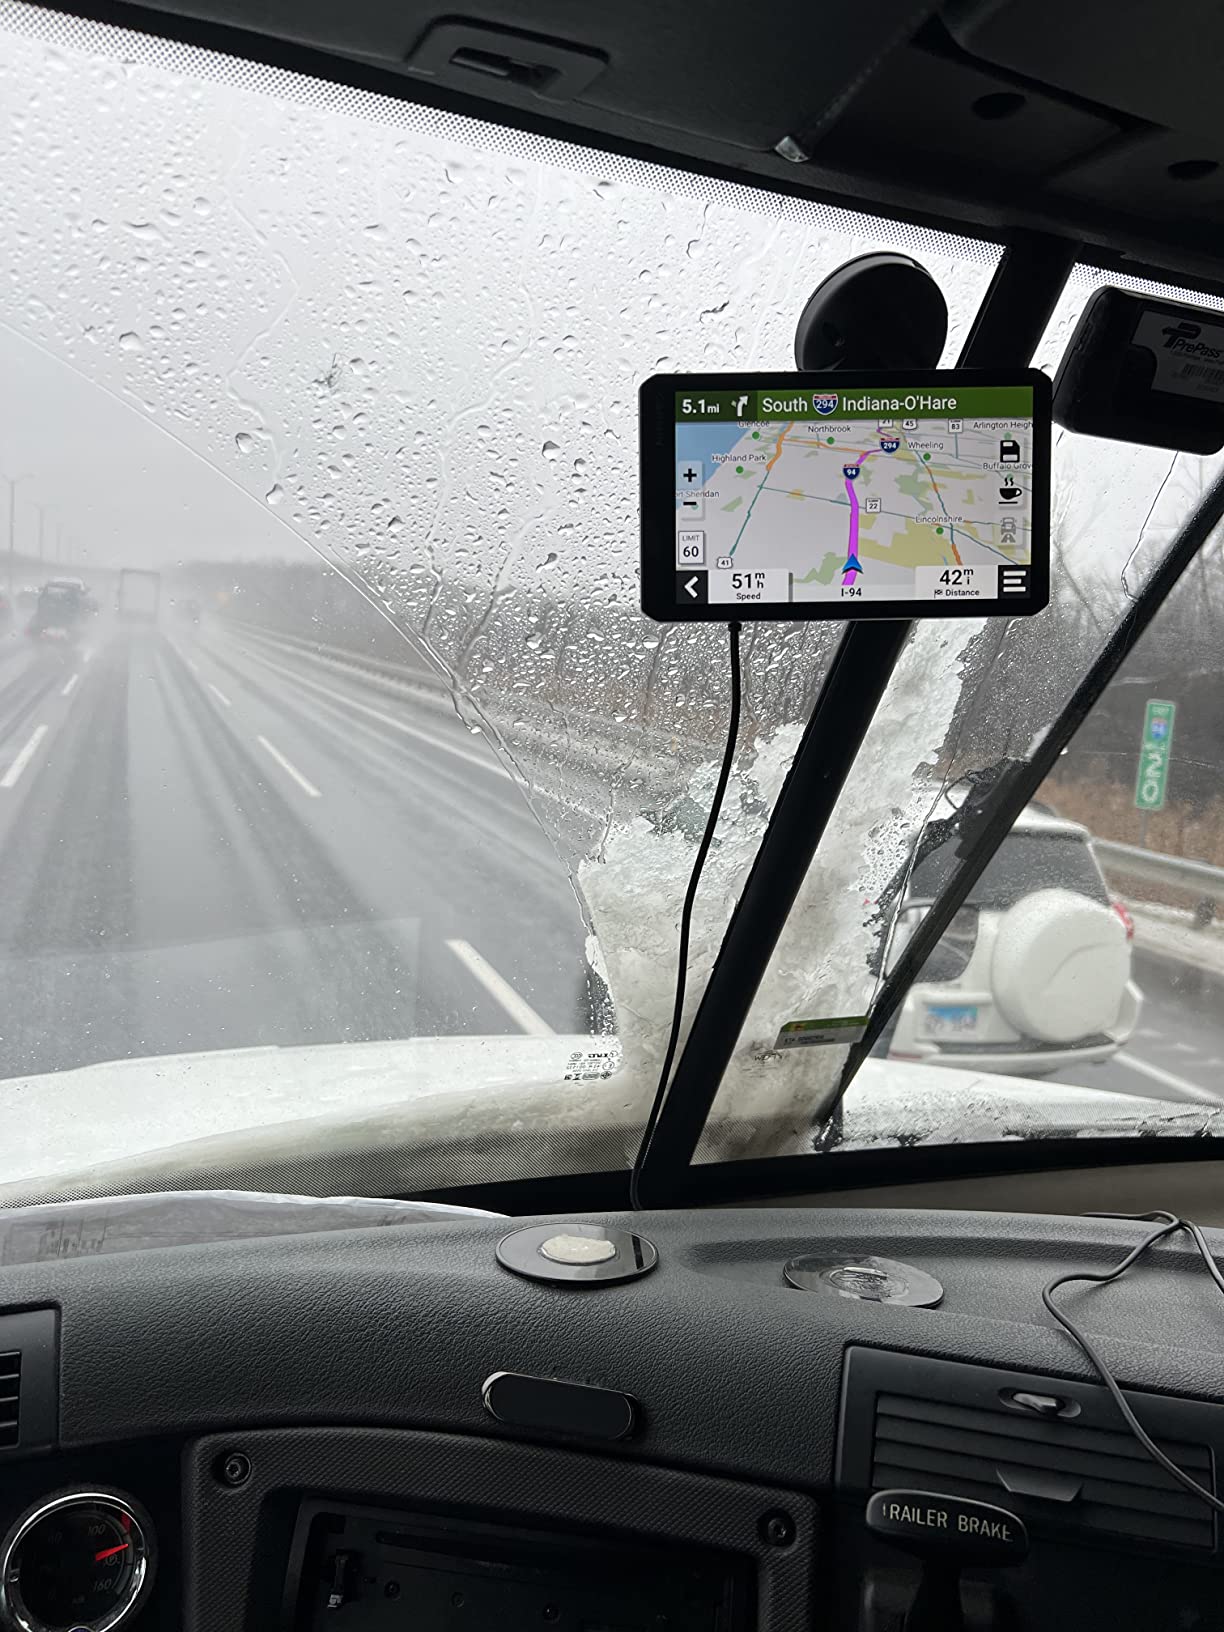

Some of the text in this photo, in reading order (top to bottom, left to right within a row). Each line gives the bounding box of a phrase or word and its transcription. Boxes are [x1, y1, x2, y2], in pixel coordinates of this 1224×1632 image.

[1174, 336, 1222, 359] PrePass
[762, 395, 957, 413] South 294 Indiana-O'Hare
[808, 425, 851, 433] Northbrook
[973, 421, 1008, 430] Arlington
[883, 441, 897, 450] 294
[908, 441, 944, 450] Wheeling
[712, 454, 767, 462] Highland Park
[983, 462, 1013, 470] Buffalo
[847, 468, 856, 476] 94
[685, 490, 720, 498] Sheridan
[869, 502, 878, 510] 22
[915, 515, 963, 523] Lincolnshire
[683, 546, 699, 558] 60
[732, 574, 752, 589] 51
[939, 570, 963, 585] 42
[841, 587, 862, 597] I-94
[945, 588, 980, 597] Distance
[736, 592, 761, 602] Speed
[958, 1515, 1014, 1542] BRAKE
